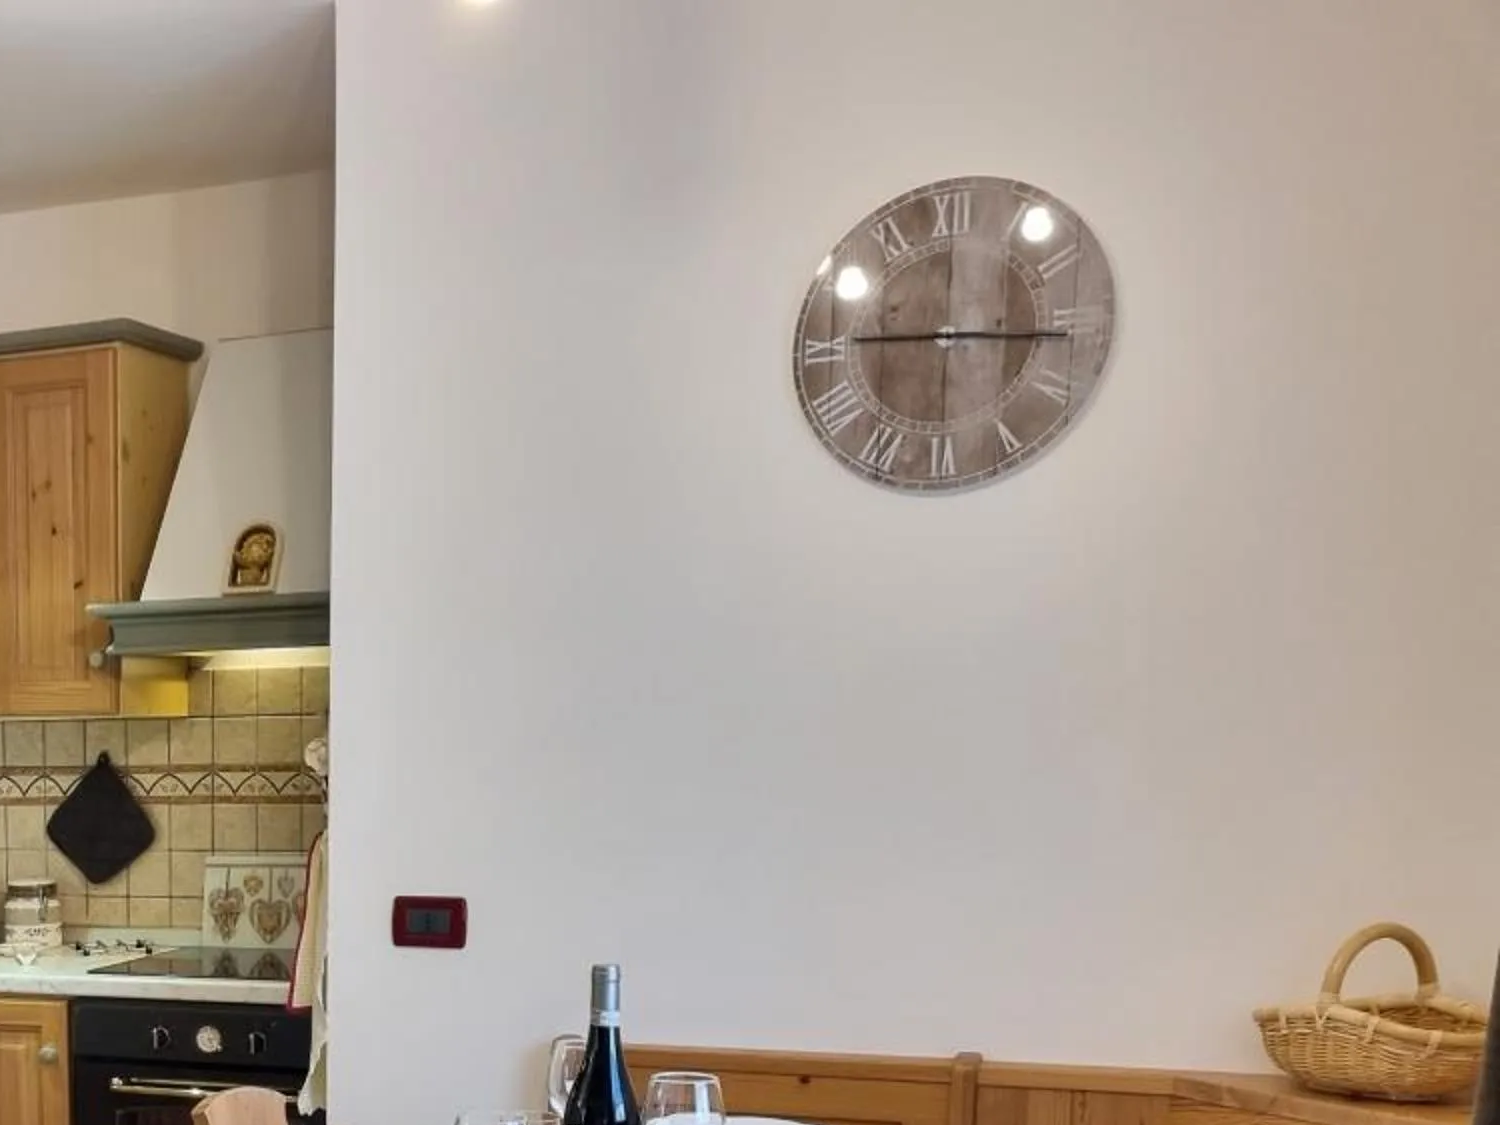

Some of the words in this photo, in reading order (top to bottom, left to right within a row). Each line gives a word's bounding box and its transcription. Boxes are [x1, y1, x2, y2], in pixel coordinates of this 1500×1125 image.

[932, 191, 971, 239] XII
[871, 216, 912, 262] XI
[804, 336, 846, 364] IX
